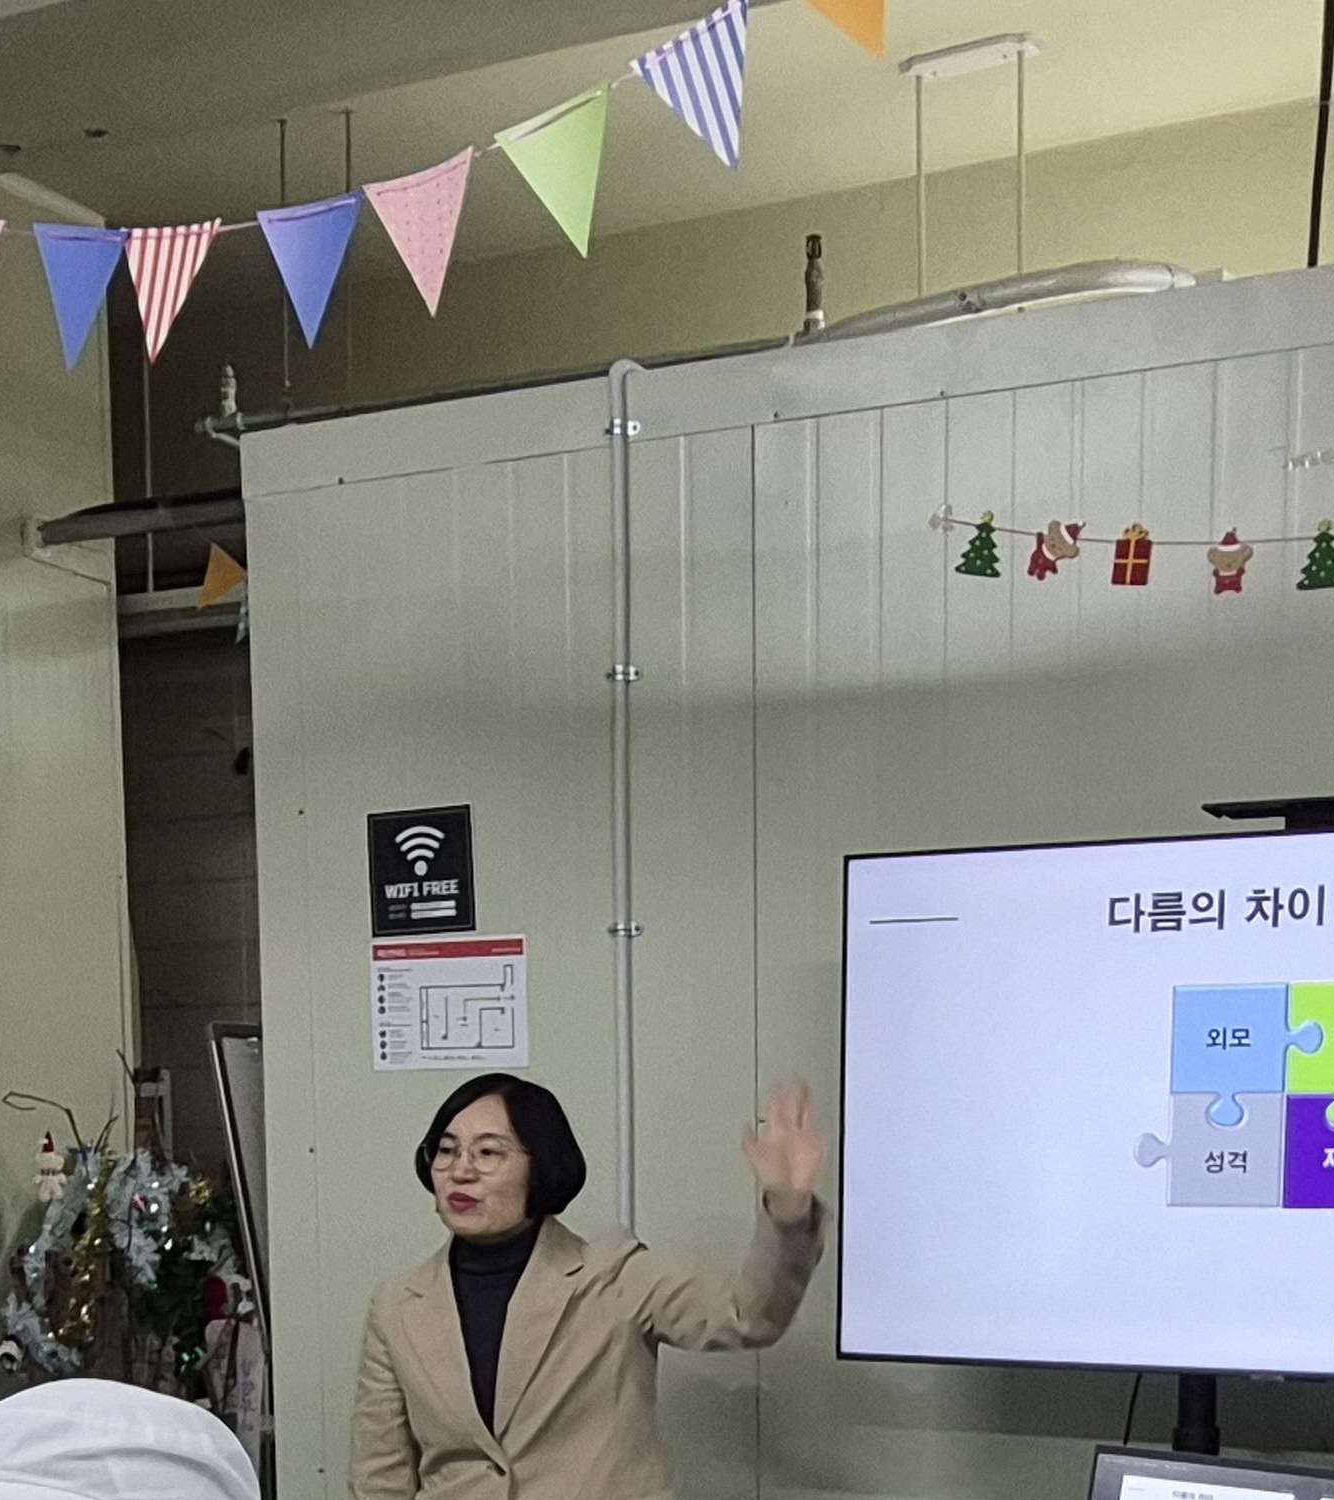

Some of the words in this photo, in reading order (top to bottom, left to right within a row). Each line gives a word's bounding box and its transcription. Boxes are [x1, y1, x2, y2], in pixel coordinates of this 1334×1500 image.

[384, 882, 420, 899] WIFI
[423, 878, 459, 896] FREE
[1108, 889, 1225, 933] 다름의
[1245, 884, 1325, 928] 차이
[1205, 1026, 1252, 1050] 외모
[1204, 1150, 1248, 1174] 성격
